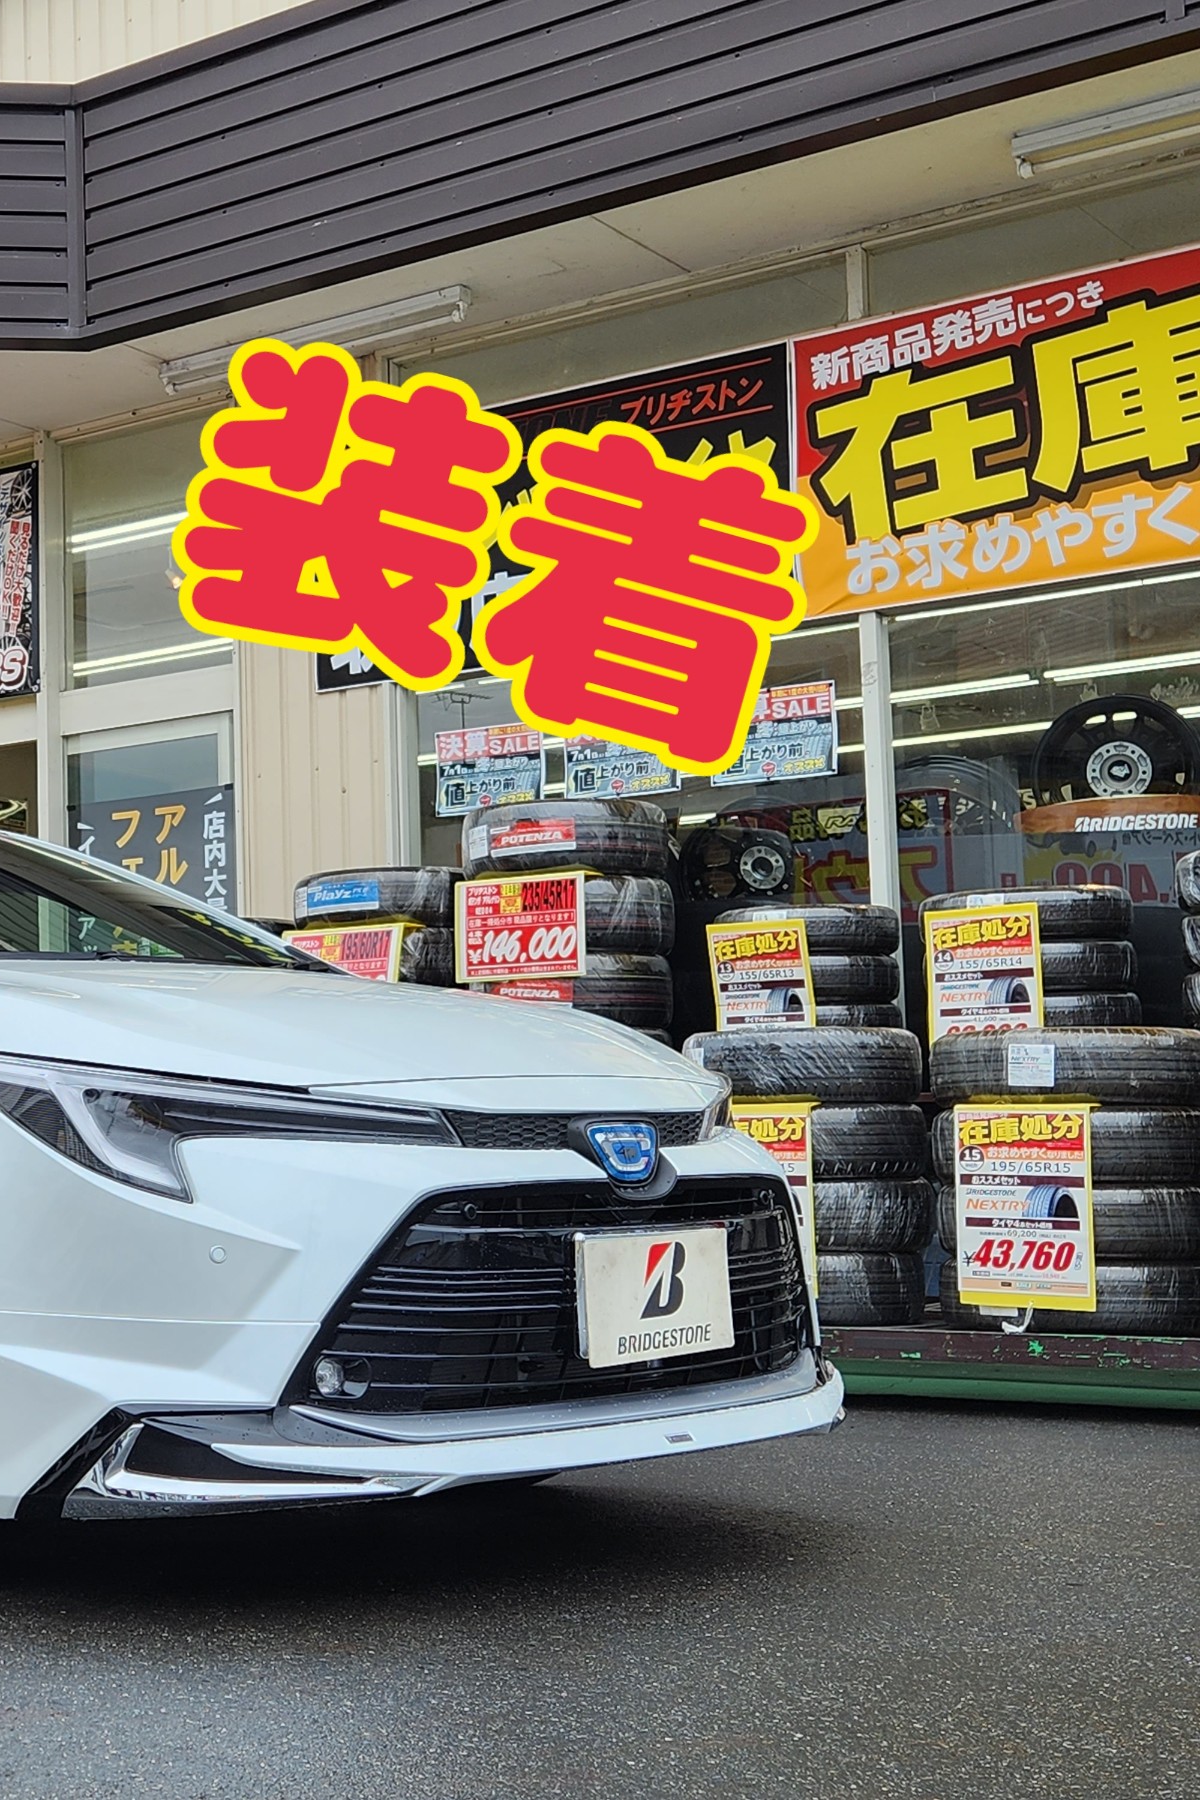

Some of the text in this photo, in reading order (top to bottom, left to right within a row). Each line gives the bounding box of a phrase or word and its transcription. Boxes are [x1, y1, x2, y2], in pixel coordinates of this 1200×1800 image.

[810, 280, 1105, 391] 新商品発売につき
[620, 377, 764, 426] ブリヂストン
[845, 485, 1200, 595] お求めやすく
[771, 696, 830, 719] SALE
[440, 731, 540, 759] 決算 SALE
[1074, 813, 1199, 833] BRIDGESTONE
[501, 831, 563, 846] POTENZA
[933, 915, 1030, 950] 在庫処分
[467, 925, 577, 964] ¥146,000
[714, 930, 798, 961] 在庫処分
[936, 952, 951, 962] 14
[959, 957, 1023, 970] 155/65R14
[720, 963, 731, 972] 13
[739, 969, 795, 980] 155/65R13
[500, 987, 560, 999] POTENZA
[940, 991, 991, 1003] NEXTRY
[726, 1000, 769, 1011] NEXTRY
[959, 1113, 1083, 1146] 在庫処分
[963, 1149, 981, 1161] 15
[987, 1146, 1084, 1159] お求めやすくなりました!
[991, 1161, 1072, 1174] 195/65R15
[971, 1175, 1021, 1186] おススメセット
[965, 1188, 1017, 1196] BRIDGESTONE
[966, 1198, 1029, 1211] NEXTRY
[1007, 1229, 1037, 1239] 69,200
[962, 1239, 1076, 1272] ¥43,760
[617, 1323, 712, 1356] BRIDGESTONE
